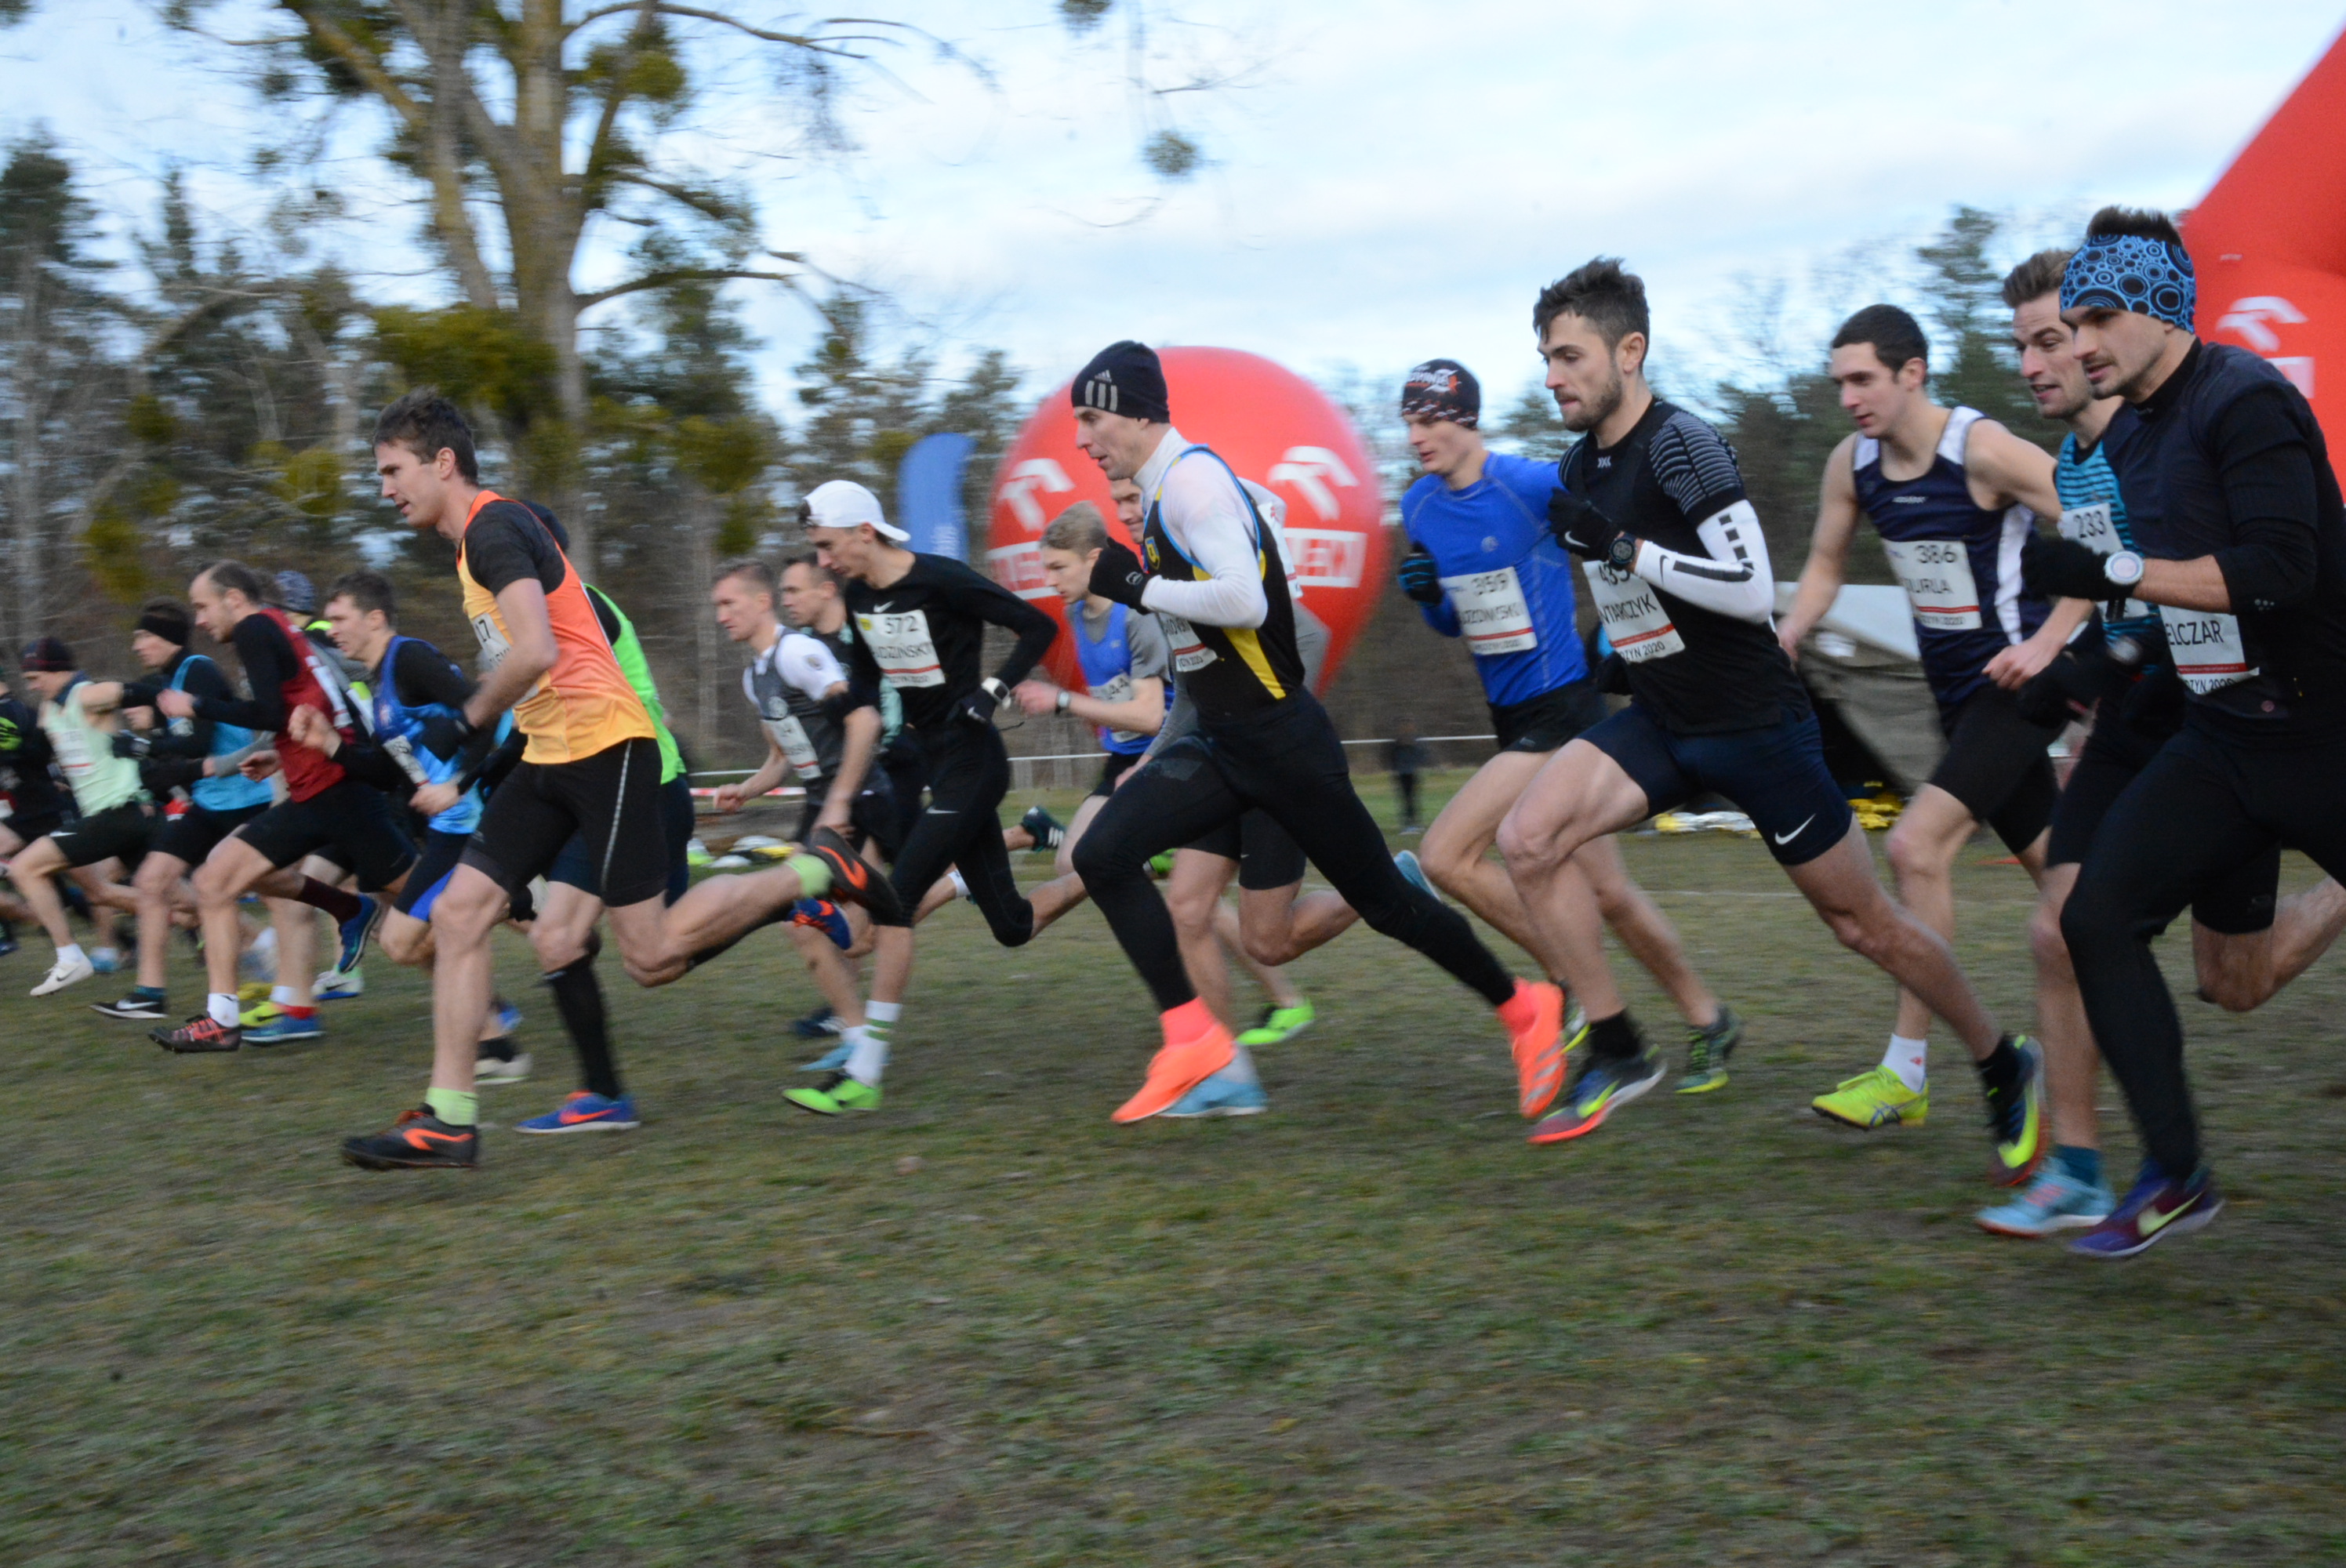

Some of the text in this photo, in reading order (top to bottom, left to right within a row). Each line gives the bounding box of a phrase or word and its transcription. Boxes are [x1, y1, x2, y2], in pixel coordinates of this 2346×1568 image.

[2072, 510, 2107, 538] 233
[1915, 544, 1958, 564] 386
[884, 615, 919, 634] 572
[1642, 641, 1666, 655] 2020
